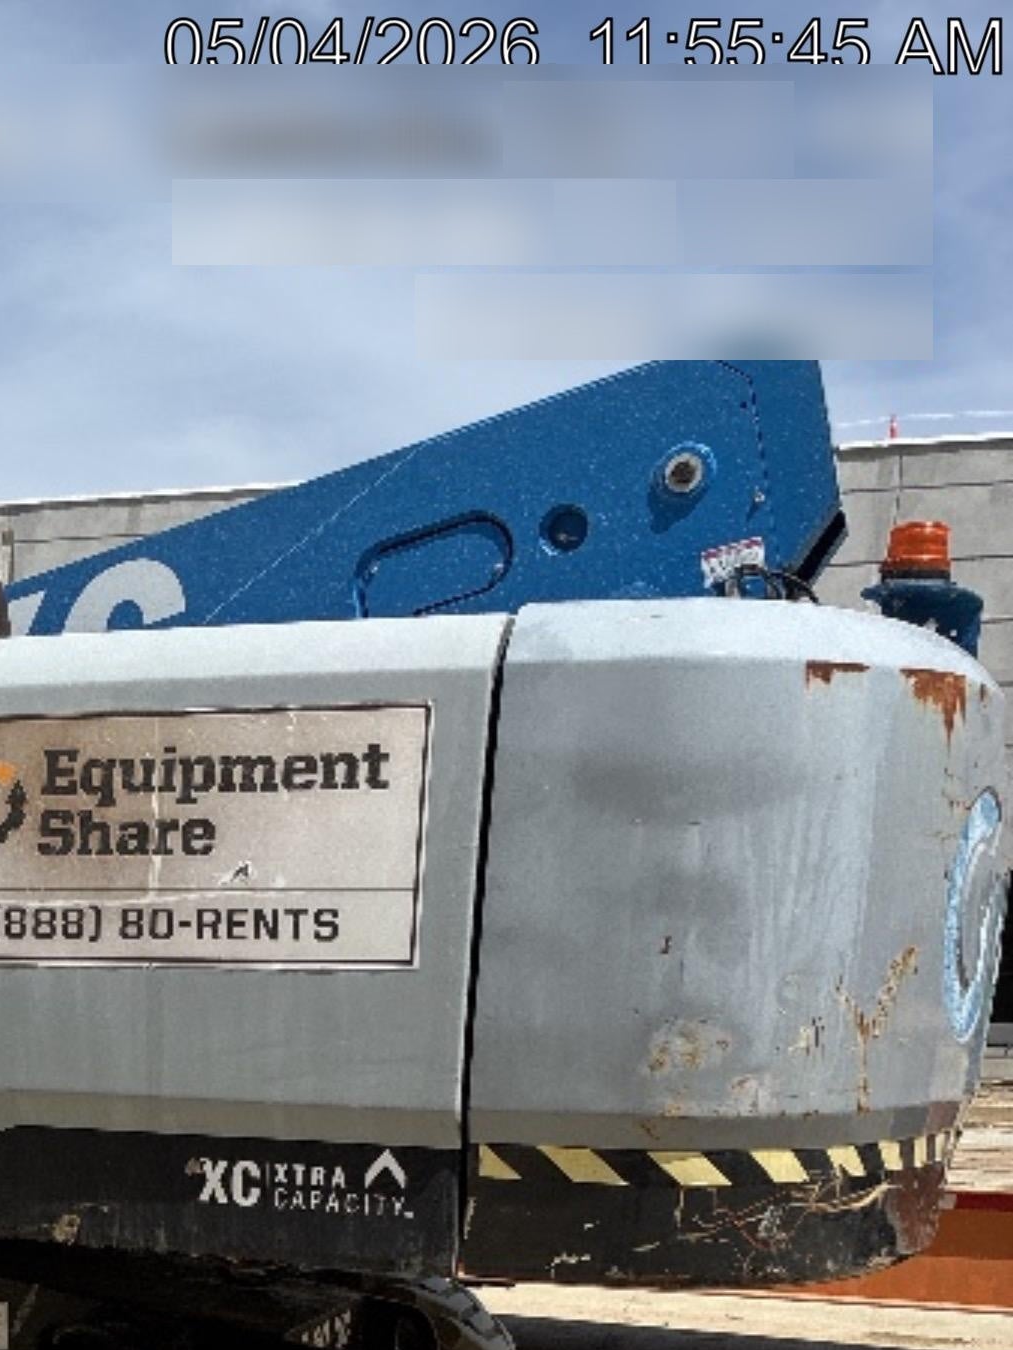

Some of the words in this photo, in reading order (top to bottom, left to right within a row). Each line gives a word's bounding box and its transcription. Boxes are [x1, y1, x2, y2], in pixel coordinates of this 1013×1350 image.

[41, 743, 390, 806] Equipment
[37, 809, 216, 856] Share
[119, 907, 340, 942] 80-RENTS
[199, 1157, 261, 1207] XC
[274, 1162, 346, 1189] XTRA
